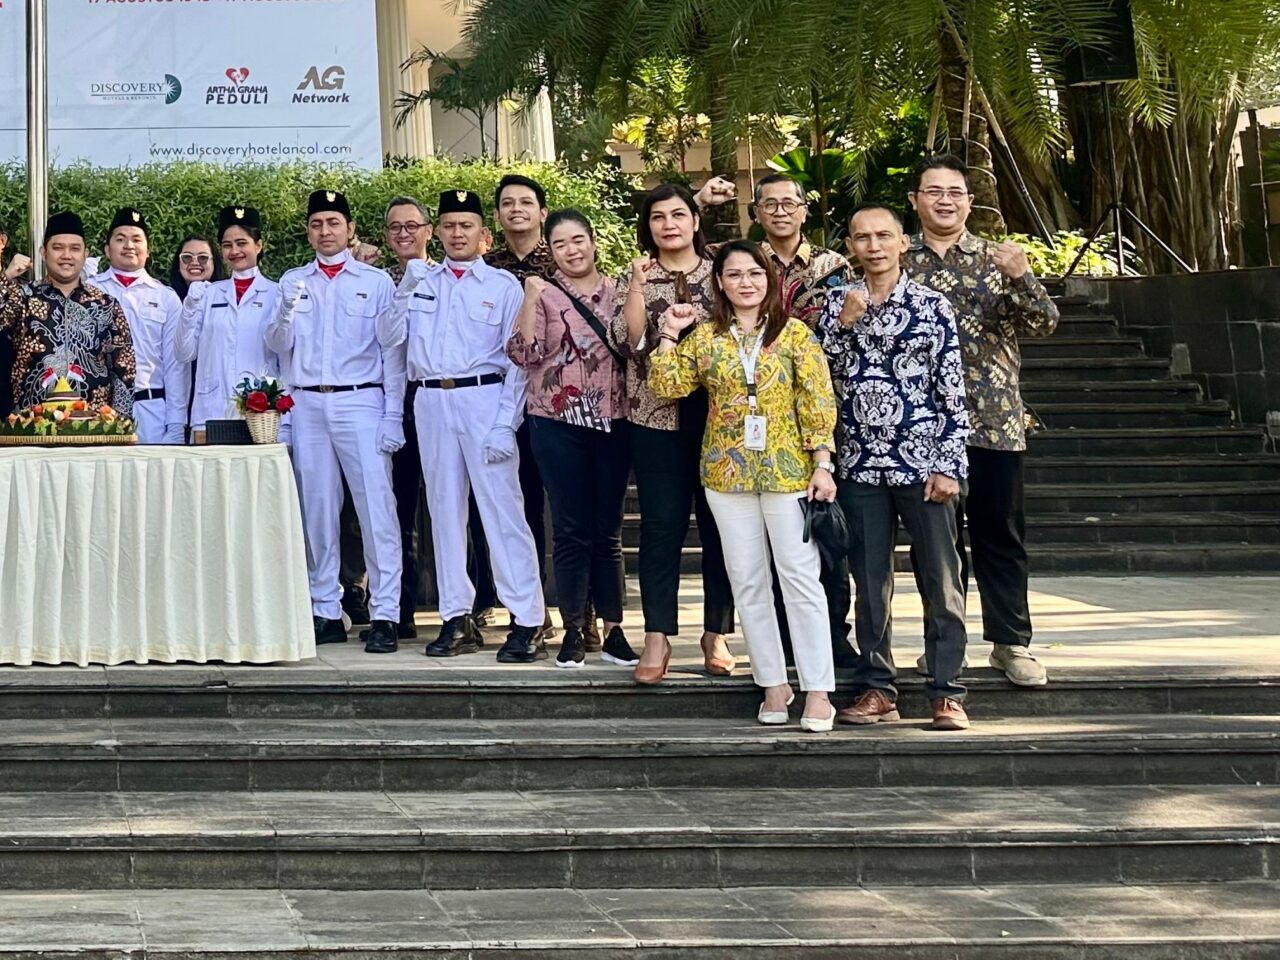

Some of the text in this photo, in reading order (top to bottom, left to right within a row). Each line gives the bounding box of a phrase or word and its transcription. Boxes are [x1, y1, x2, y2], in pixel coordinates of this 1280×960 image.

[296, 65, 345, 90] AG
[91, 82, 165, 93] DISCOVERY
[207, 85, 268, 94] ARTHA GRAHA
[205, 93, 268, 105] PEDULI
[291, 92, 351, 104] Network
[150, 141, 352, 158] www.discoveryhotelancol.com
